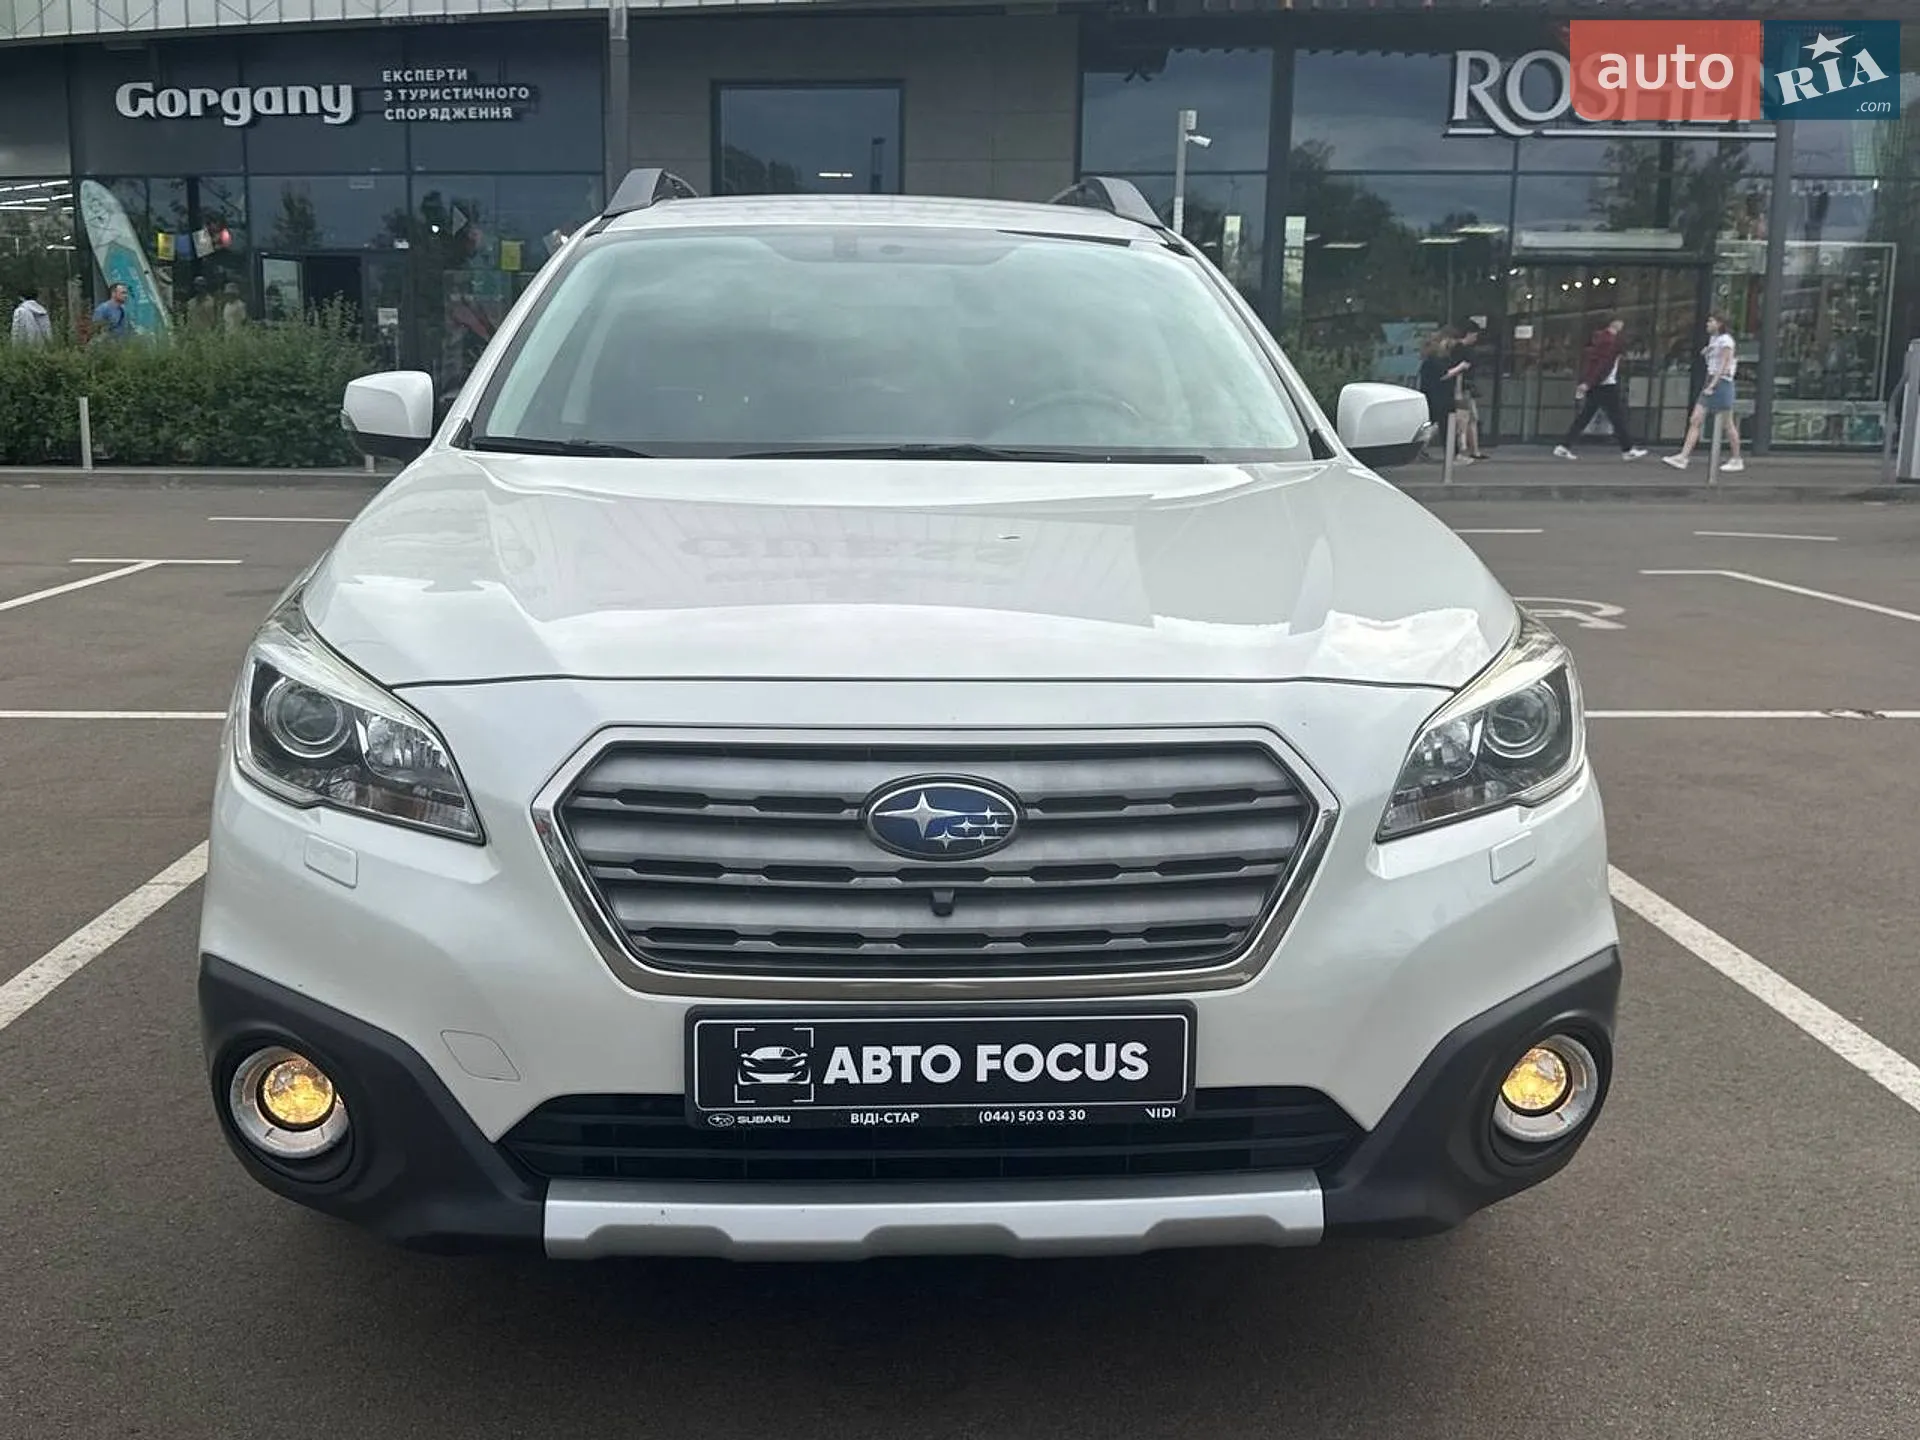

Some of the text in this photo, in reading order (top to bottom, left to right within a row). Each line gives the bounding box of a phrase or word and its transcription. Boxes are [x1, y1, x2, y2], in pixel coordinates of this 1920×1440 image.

[382, 68, 468, 83] ЕКСПЕРТИ
[398, 86, 530, 100] ТУРИСТИЧНОГО
[115, 82, 353, 126] Gorgany
[384, 106, 514, 121] СПОРЯДЖЕННЯ
[976, 1042, 1149, 1083] FOCUS
[737, 1115, 791, 1124] SUBARU
[978, 1108, 1086, 1123] (044) 503 03 30
